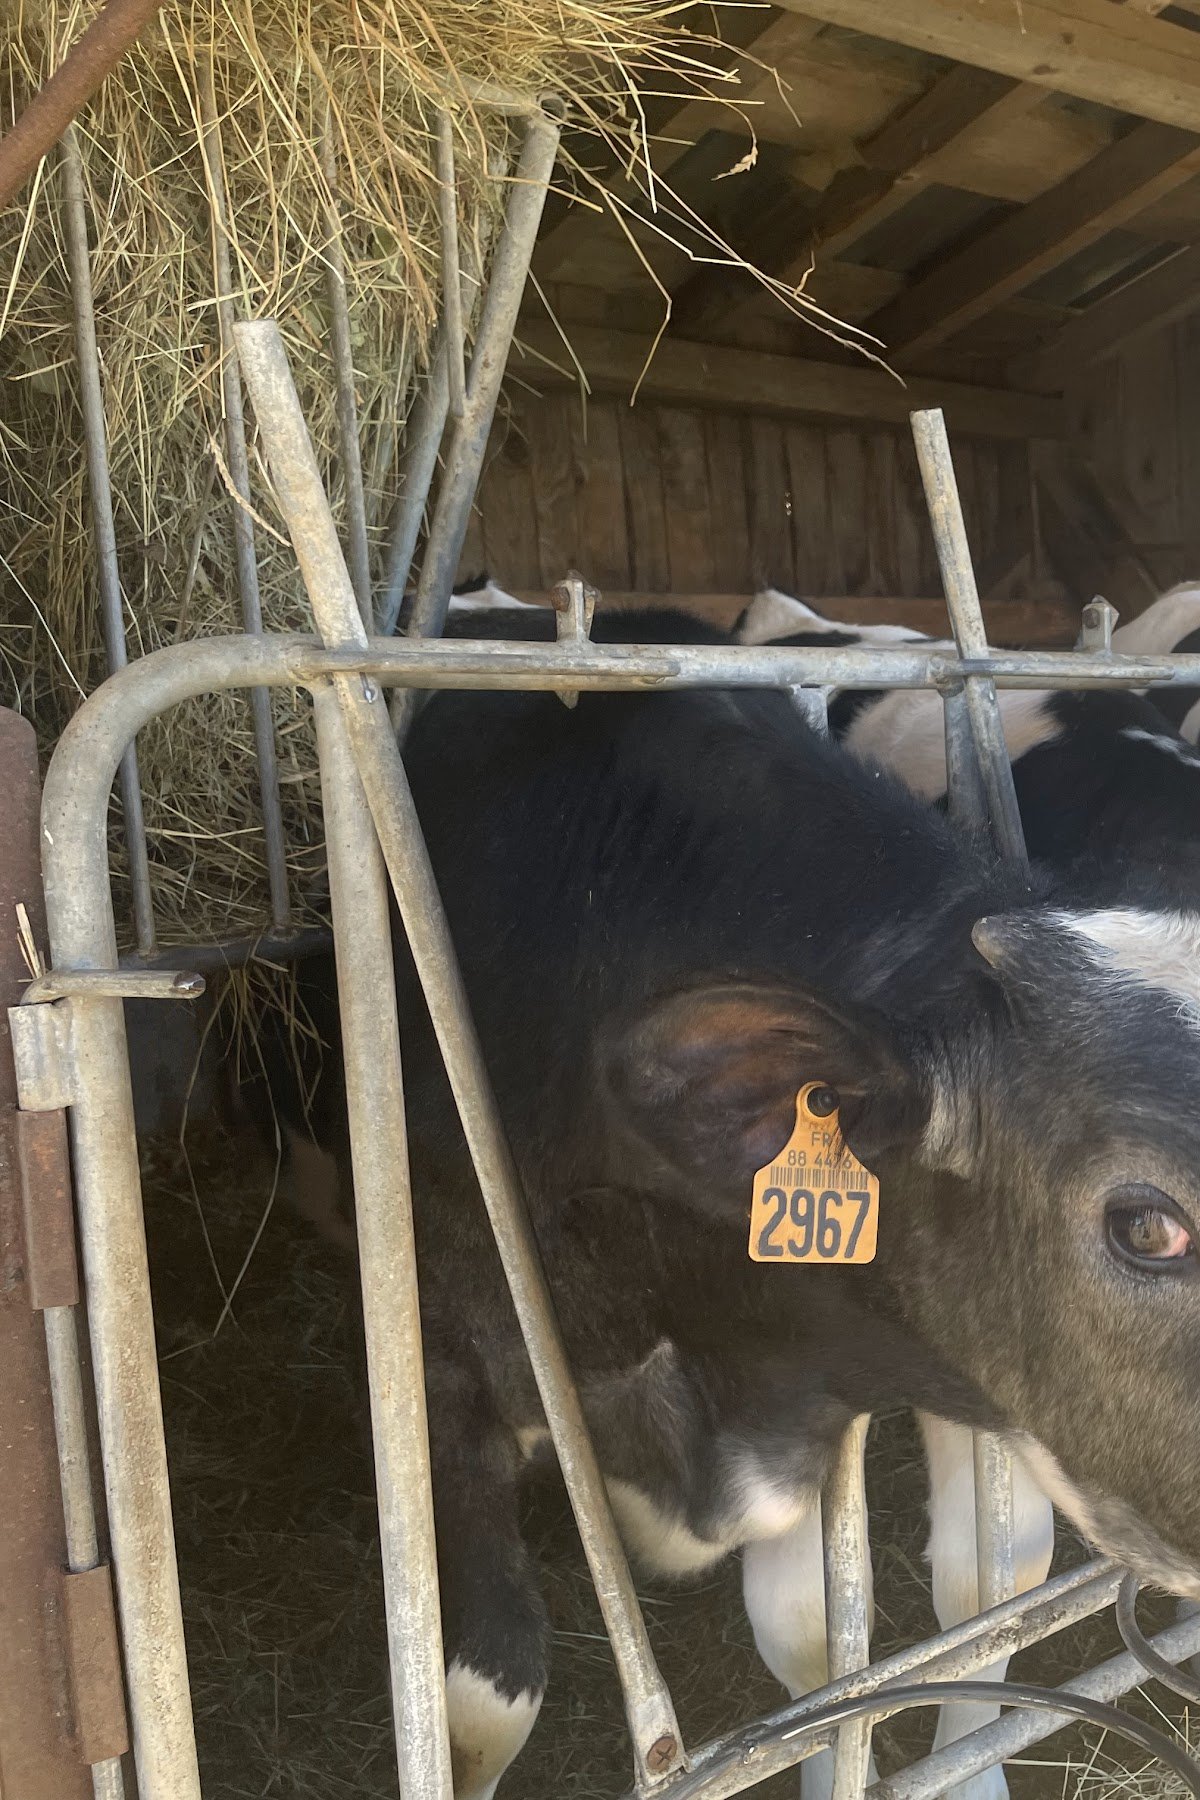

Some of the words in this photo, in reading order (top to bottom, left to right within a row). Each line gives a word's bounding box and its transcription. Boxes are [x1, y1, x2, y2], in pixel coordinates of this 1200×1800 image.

[811, 1131, 832, 1147] FR
[787, 1149, 807, 1167] 88
[757, 1187, 871, 1259] 2967
